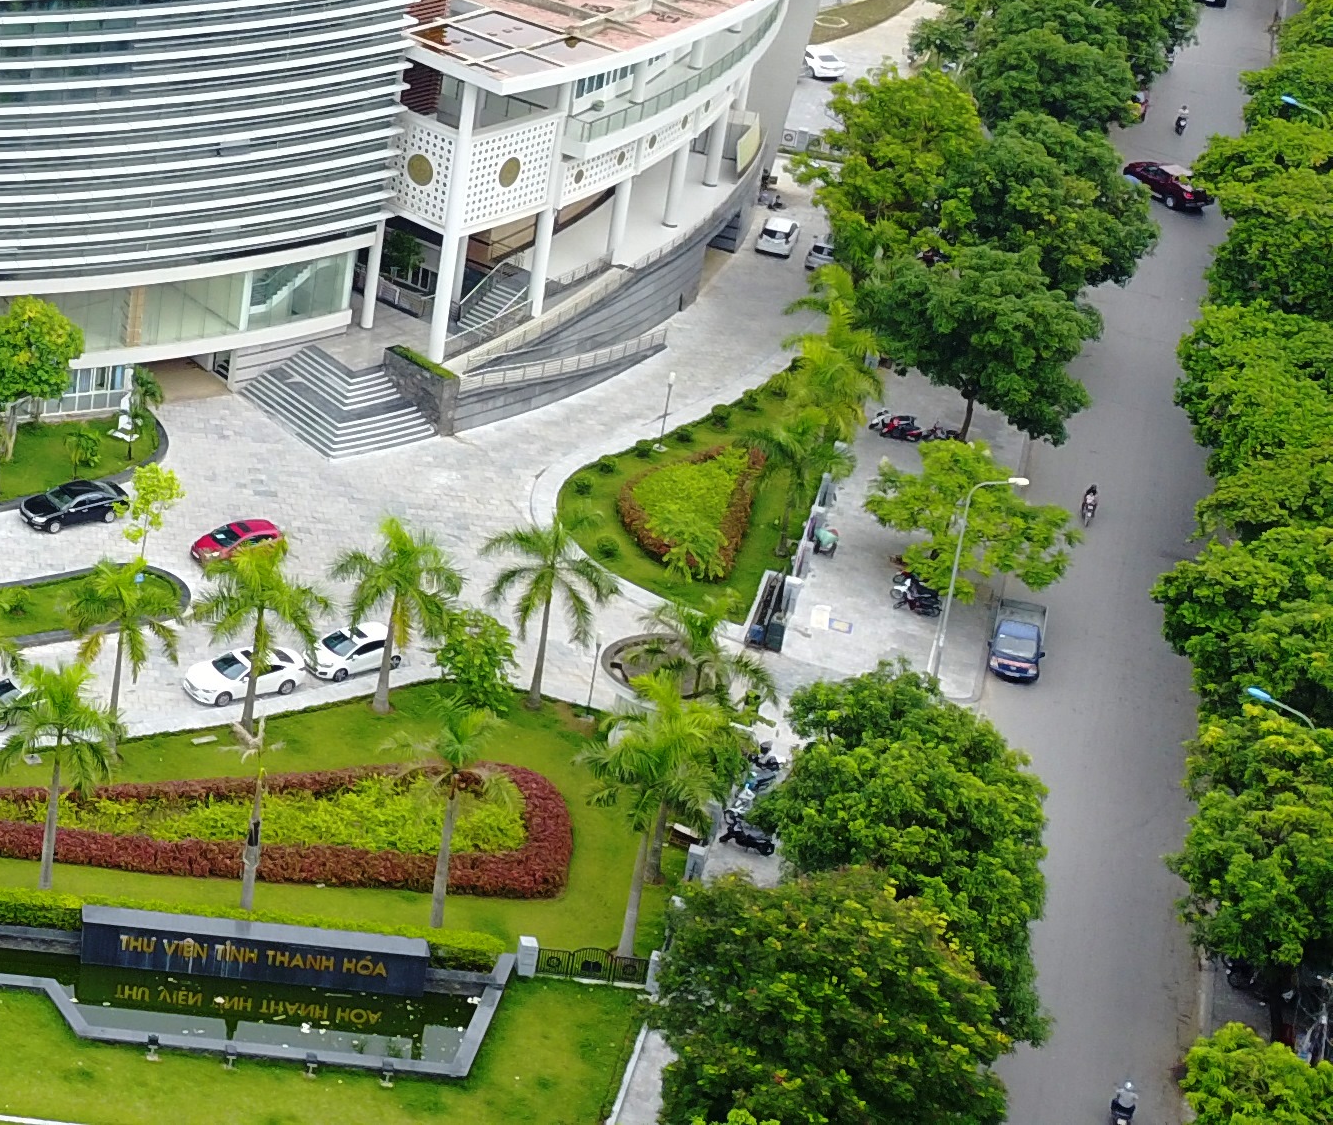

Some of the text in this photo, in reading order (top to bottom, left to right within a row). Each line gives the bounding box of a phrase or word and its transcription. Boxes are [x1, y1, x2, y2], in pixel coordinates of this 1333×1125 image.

[119, 934, 388, 978] THƯ VIỆN TỈNH THANH HÓA
